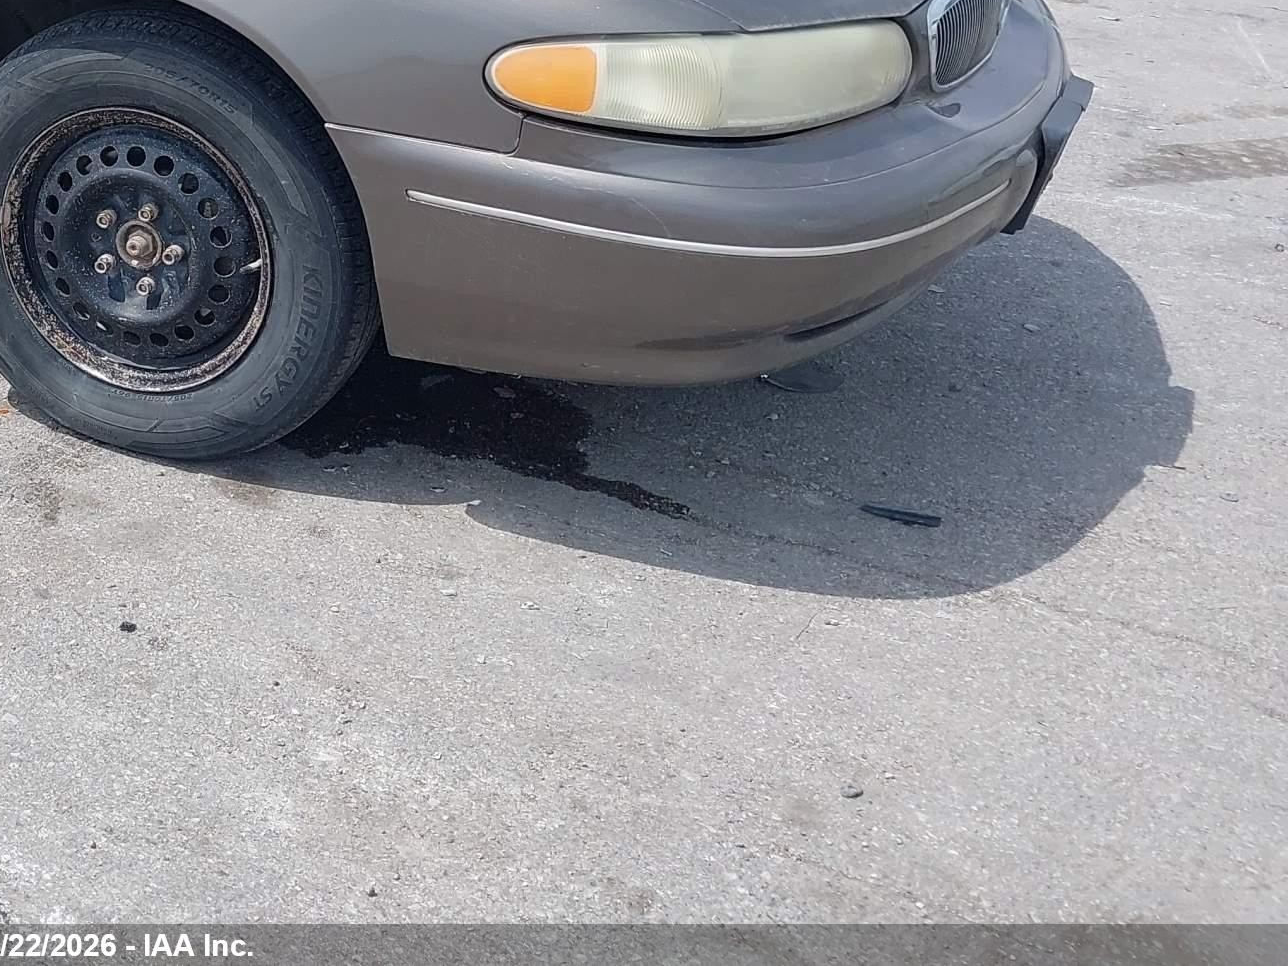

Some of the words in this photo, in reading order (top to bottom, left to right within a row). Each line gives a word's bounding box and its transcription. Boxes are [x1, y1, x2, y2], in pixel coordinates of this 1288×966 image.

[144, 62, 237, 114] 205/70R15
[274, 263, 324, 395] KINERGY
[252, 386, 273, 411] ST
